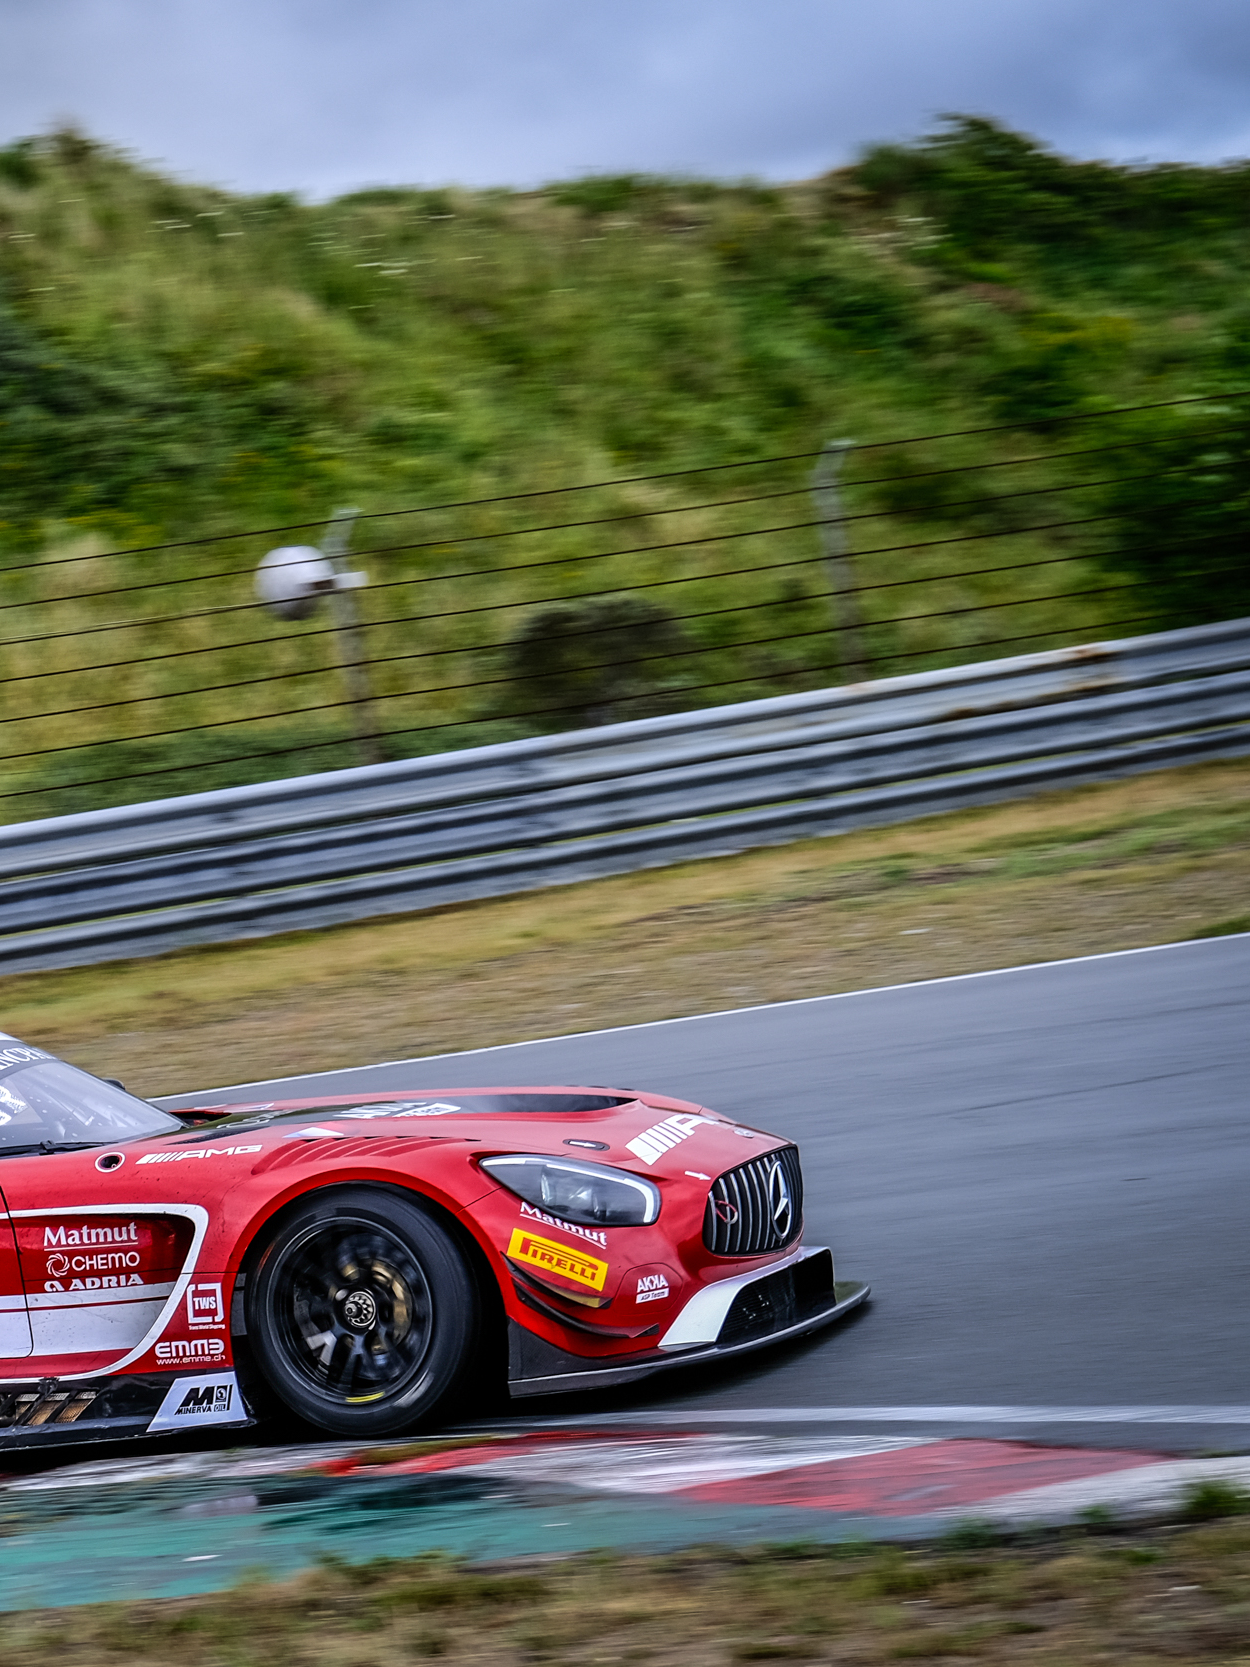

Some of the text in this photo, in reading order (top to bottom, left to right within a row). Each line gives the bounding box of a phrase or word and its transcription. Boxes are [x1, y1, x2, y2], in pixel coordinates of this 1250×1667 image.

[175, 1144, 263, 1161] AMG
[520, 1201, 607, 1246] Matmut
[44, 1221, 139, 1247] Matmut
[72, 1252, 140, 1272] CHEMO
[519, 1237, 599, 1282] PIRELLI
[68, 1273, 144, 1291] ADRIA
[637, 1274, 669, 1293] AKKA
[193, 1297, 216, 1310] TWS
[651, 1290, 665, 1299] Team
[156, 1354, 226, 1365] www.emme.ch
[174, 1404, 226, 1415] MINERVA OIL
